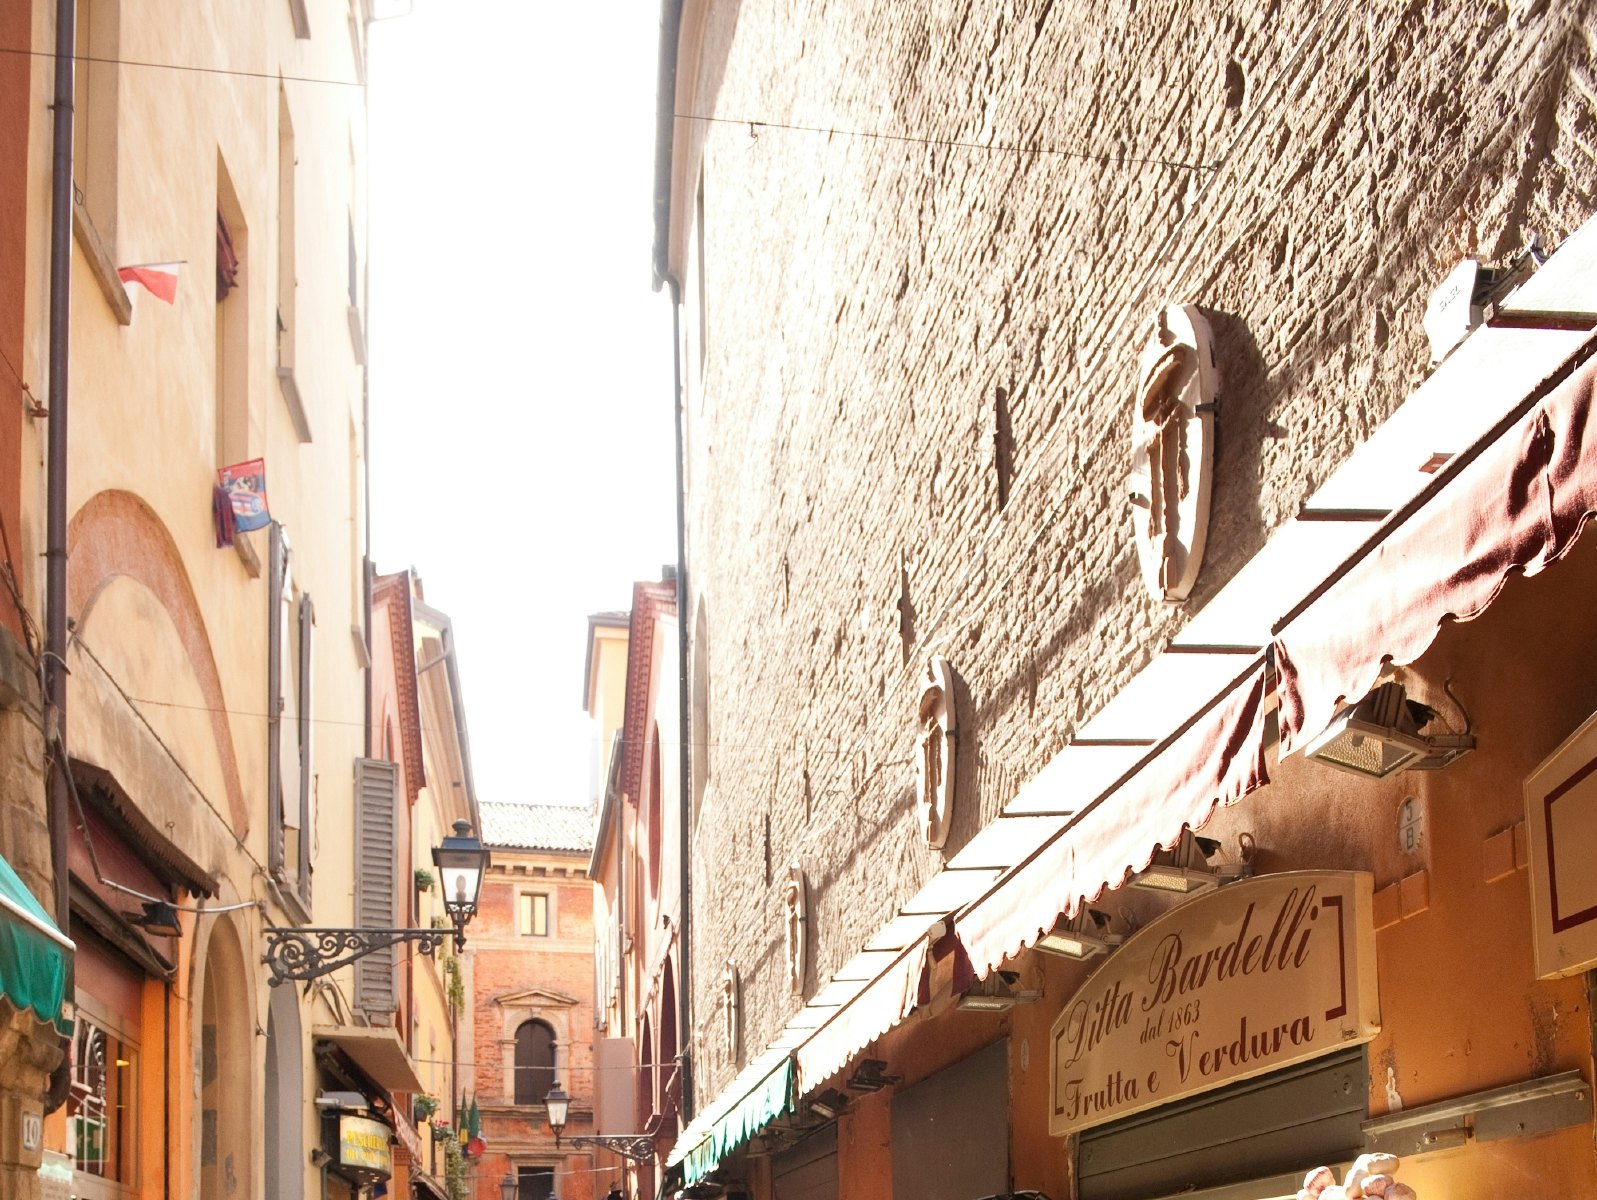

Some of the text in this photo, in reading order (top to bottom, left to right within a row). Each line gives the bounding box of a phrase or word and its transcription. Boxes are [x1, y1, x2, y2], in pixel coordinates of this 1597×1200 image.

[1064, 884, 1319, 1069] Ditta Bardelli
[1139, 1000, 1200, 1045] dal 1863
[1064, 1015, 1316, 1120] Frutta e Verdura
[26, 1118, 39, 1145] 10
